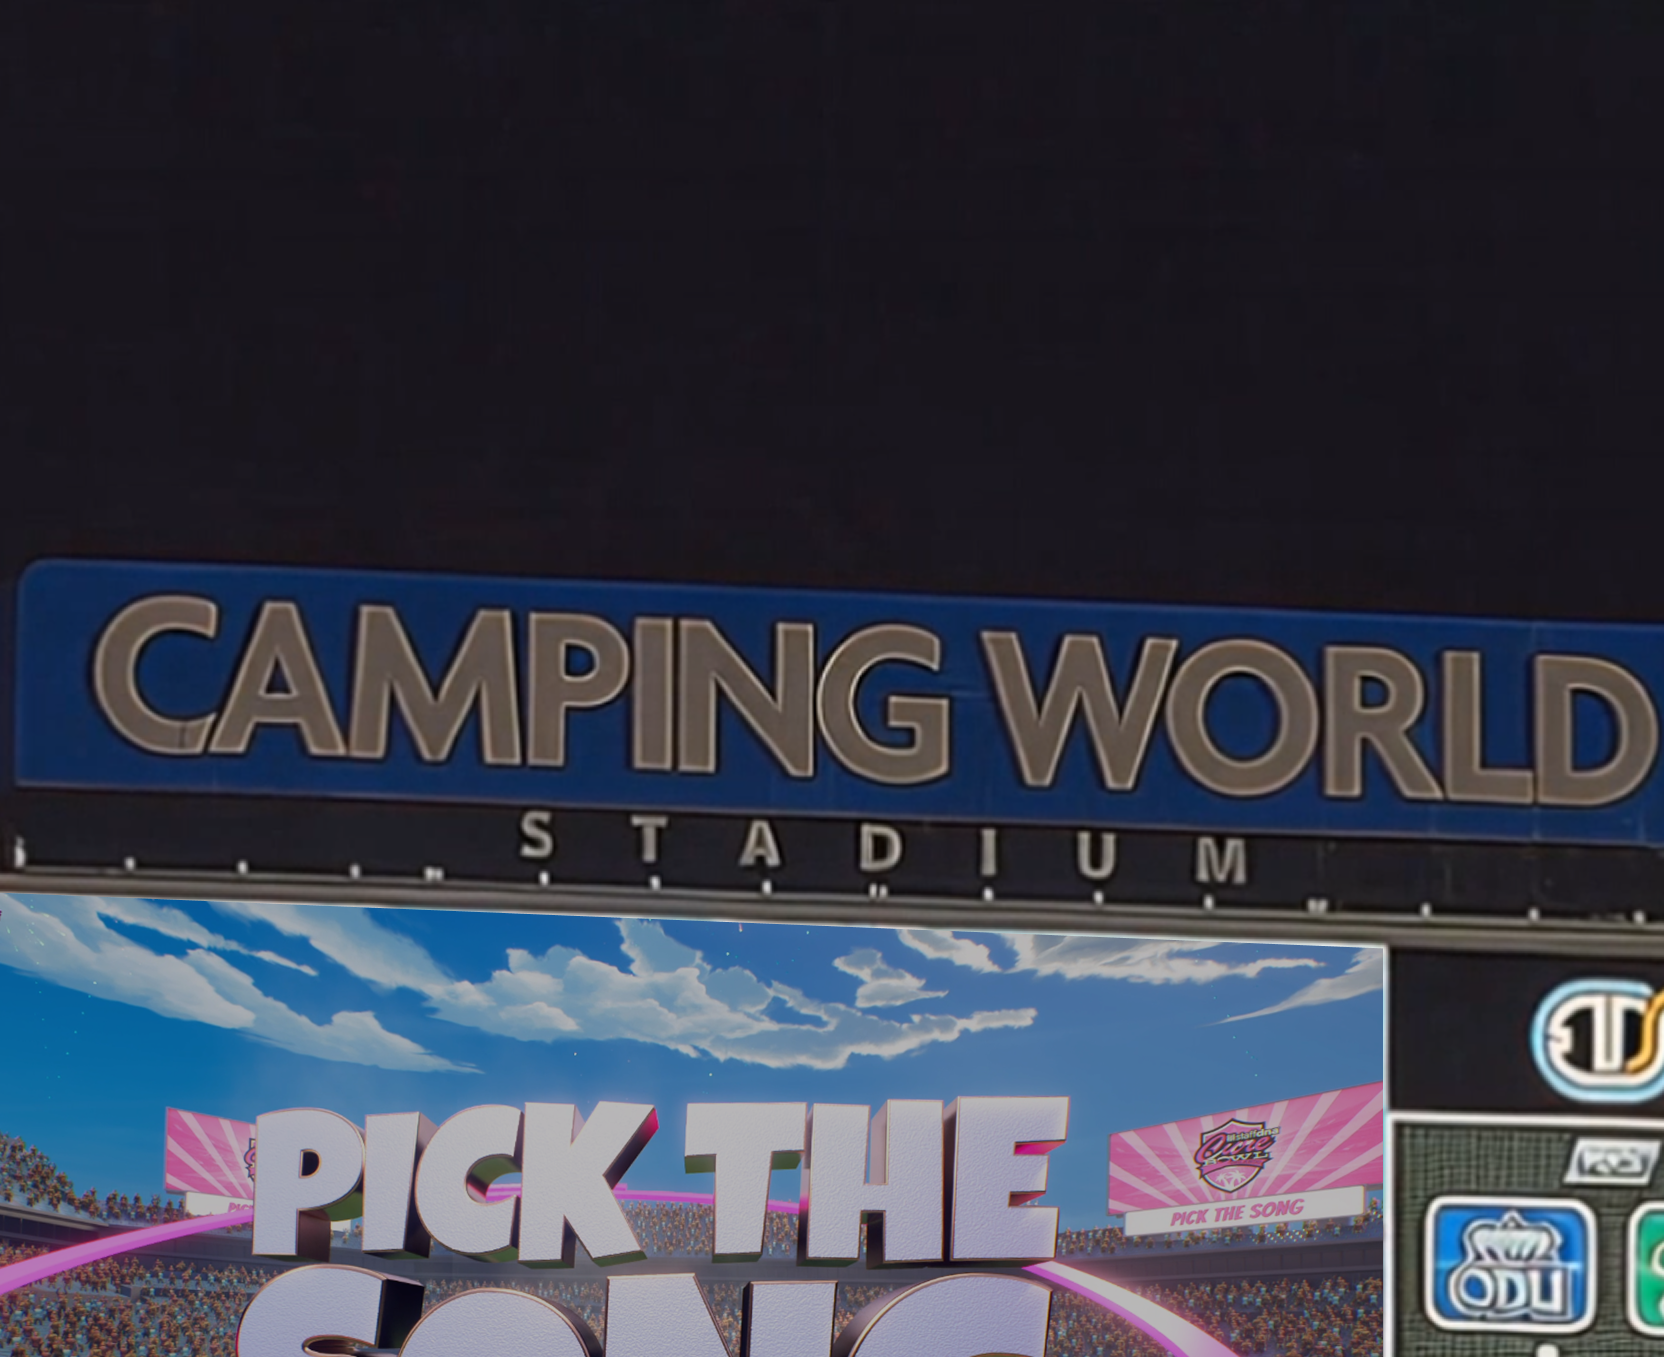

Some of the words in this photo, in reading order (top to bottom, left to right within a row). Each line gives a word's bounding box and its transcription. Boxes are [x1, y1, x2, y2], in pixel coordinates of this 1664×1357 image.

[92, 595, 950, 784] CAMPING
[980, 628, 1660, 808] WORLD
[520, 811, 1247, 884] STADIUM
[1196, 1132, 1276, 1163] Cure
[251, 1100, 659, 1268] PICK
[683, 1094, 1071, 1268] THE
[1170, 1208, 1209, 1227] PICK
[1214, 1204, 1246, 1222] THE
[1249, 1198, 1305, 1219] SONG
[1455, 1265, 1568, 1315] ODU
